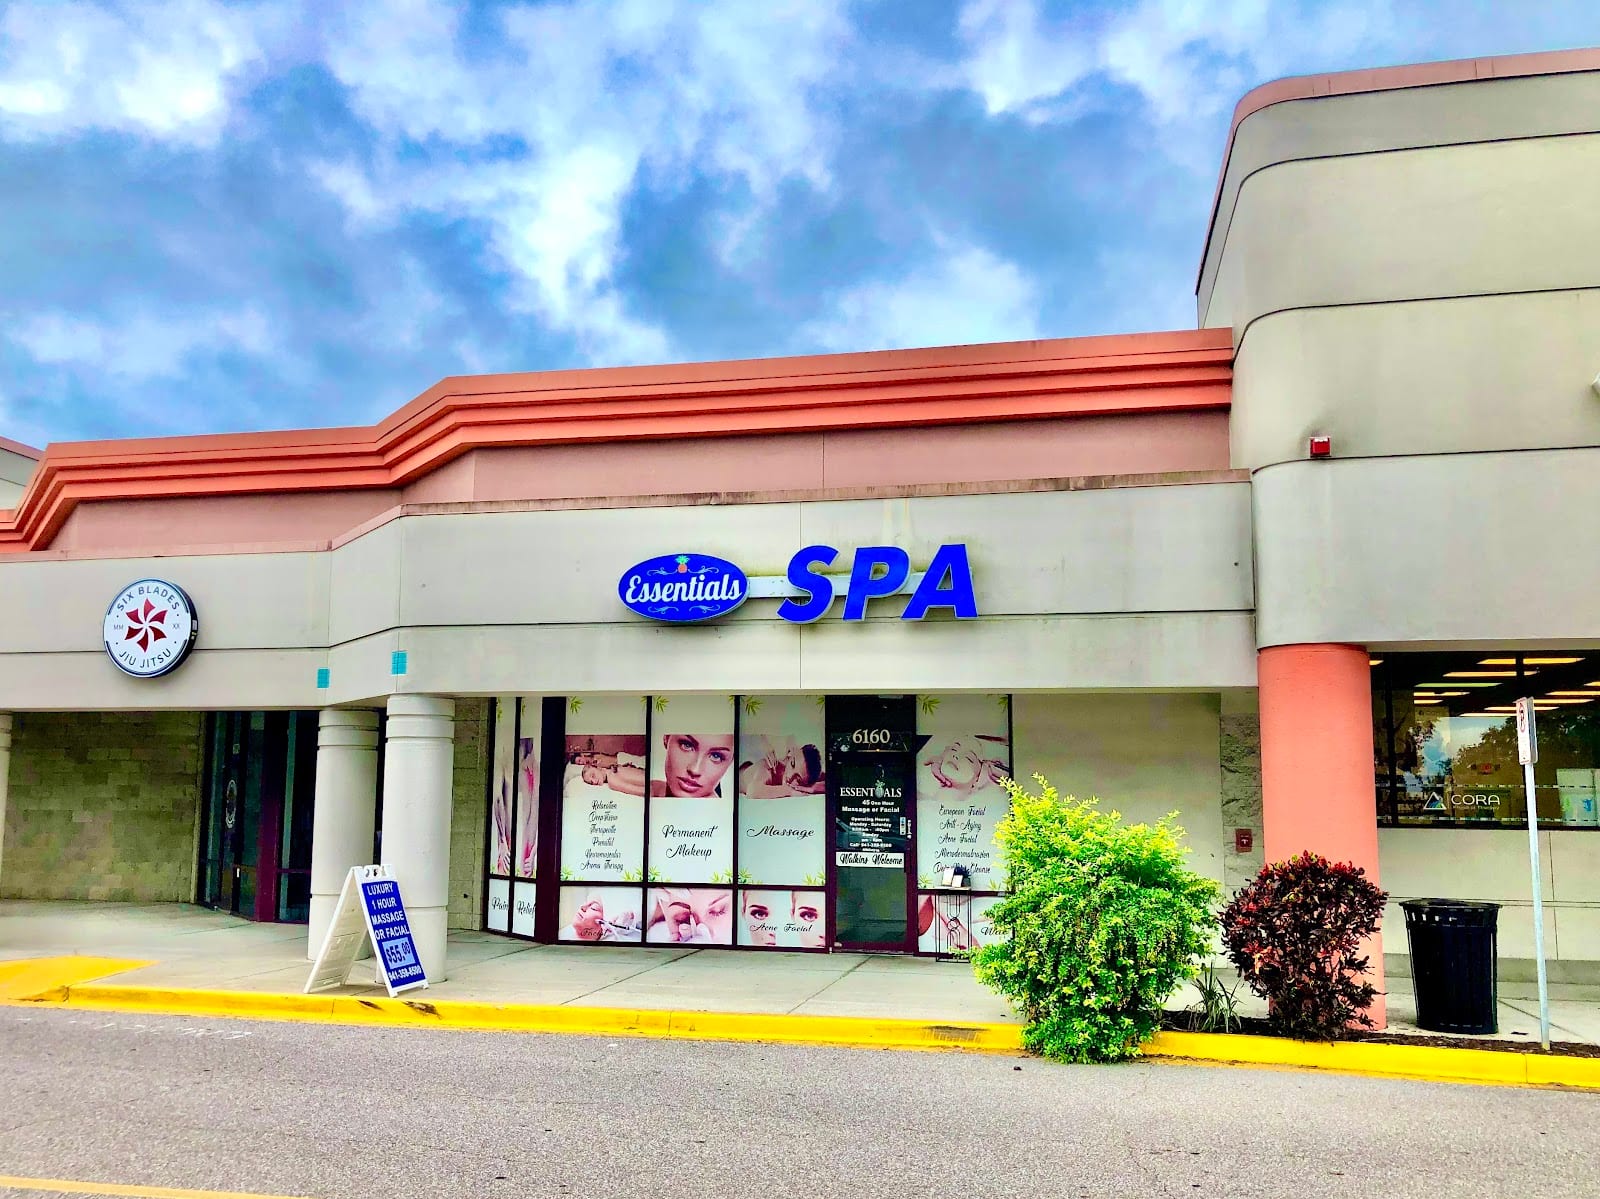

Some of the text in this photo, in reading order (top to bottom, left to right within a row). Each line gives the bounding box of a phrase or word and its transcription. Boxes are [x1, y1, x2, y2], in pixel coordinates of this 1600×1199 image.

[625, 543, 979, 624] Essentials SPA
[117, 586, 180, 611] SIX BLADES
[119, 648, 171, 668] JIU JITSU
[852, 729, 891, 744] 6160
[1451, 794, 1500, 805] CORA
[661, 824, 719, 839] Permanent
[746, 825, 815, 840] Massage
[665, 843, 712, 861] Makeup
[871, 853, 903, 865] Welcome
[367, 883, 393, 895] LUXURY
[377, 897, 397, 909] HOUR
[491, 896, 509, 910] Pain
[371, 910, 404, 925] MASSAGE
[375, 925, 410, 940] OR FACIAL
[749, 923, 813, 933] Acne Facial
